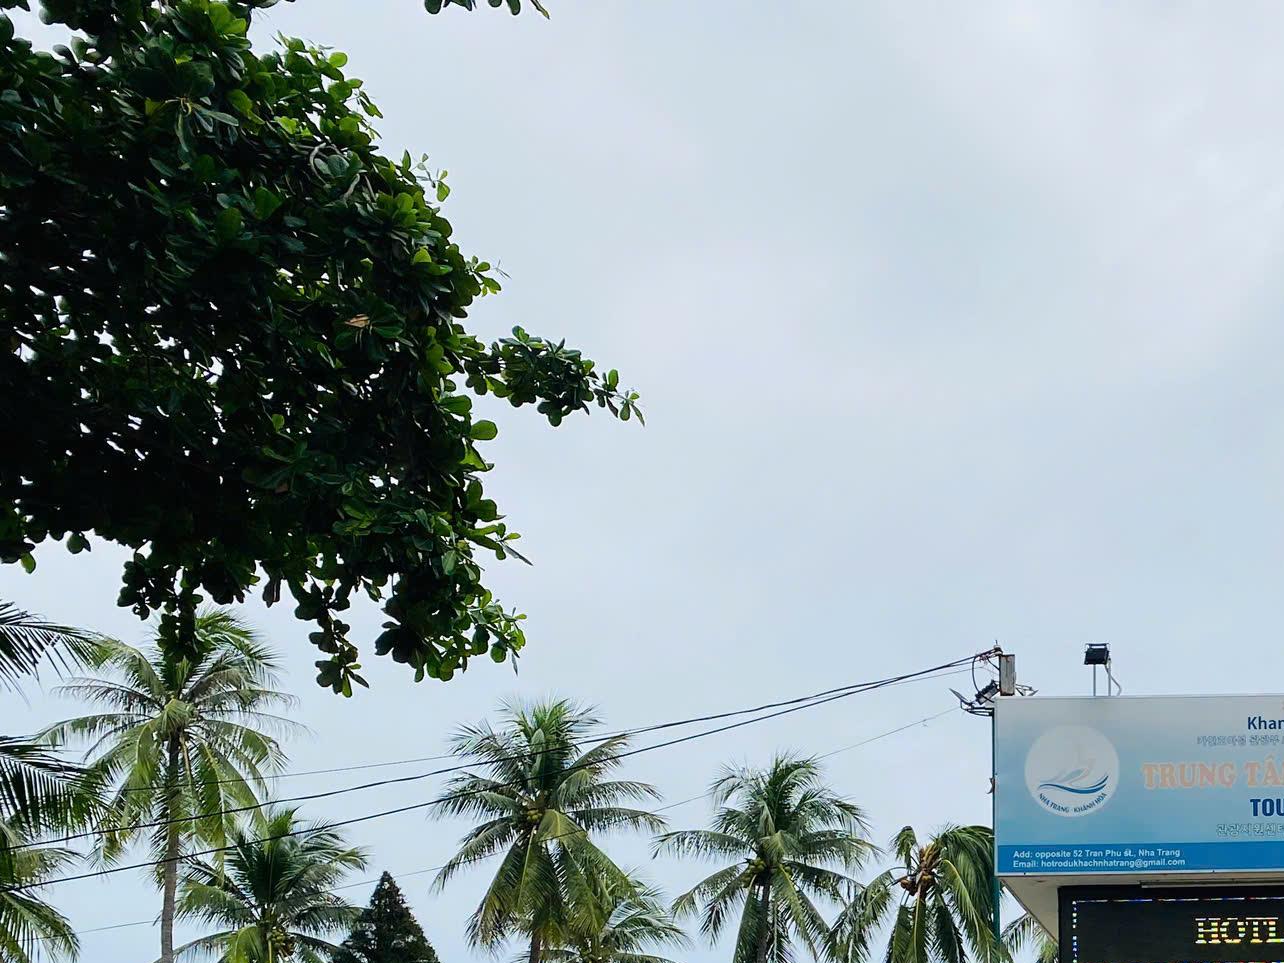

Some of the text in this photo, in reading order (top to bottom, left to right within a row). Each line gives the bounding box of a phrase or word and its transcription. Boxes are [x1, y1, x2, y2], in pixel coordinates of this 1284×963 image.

[1143, 761, 1236, 789] TRUNG
[1049, 802, 1070, 813] TRANG
[1013, 850, 1032, 859] Add:
[1034, 850, 1071, 861] opposite
[1073, 849, 1083, 858] 52
[1085, 849, 1103, 858] Tran
[1105, 849, 1122, 857] Phu
[1138, 848, 1155, 857] Nha
[1157, 848, 1181, 858] Trang
[1013, 858, 1186, 869] Email: hotrodukhachnhatrang@gmail.com
